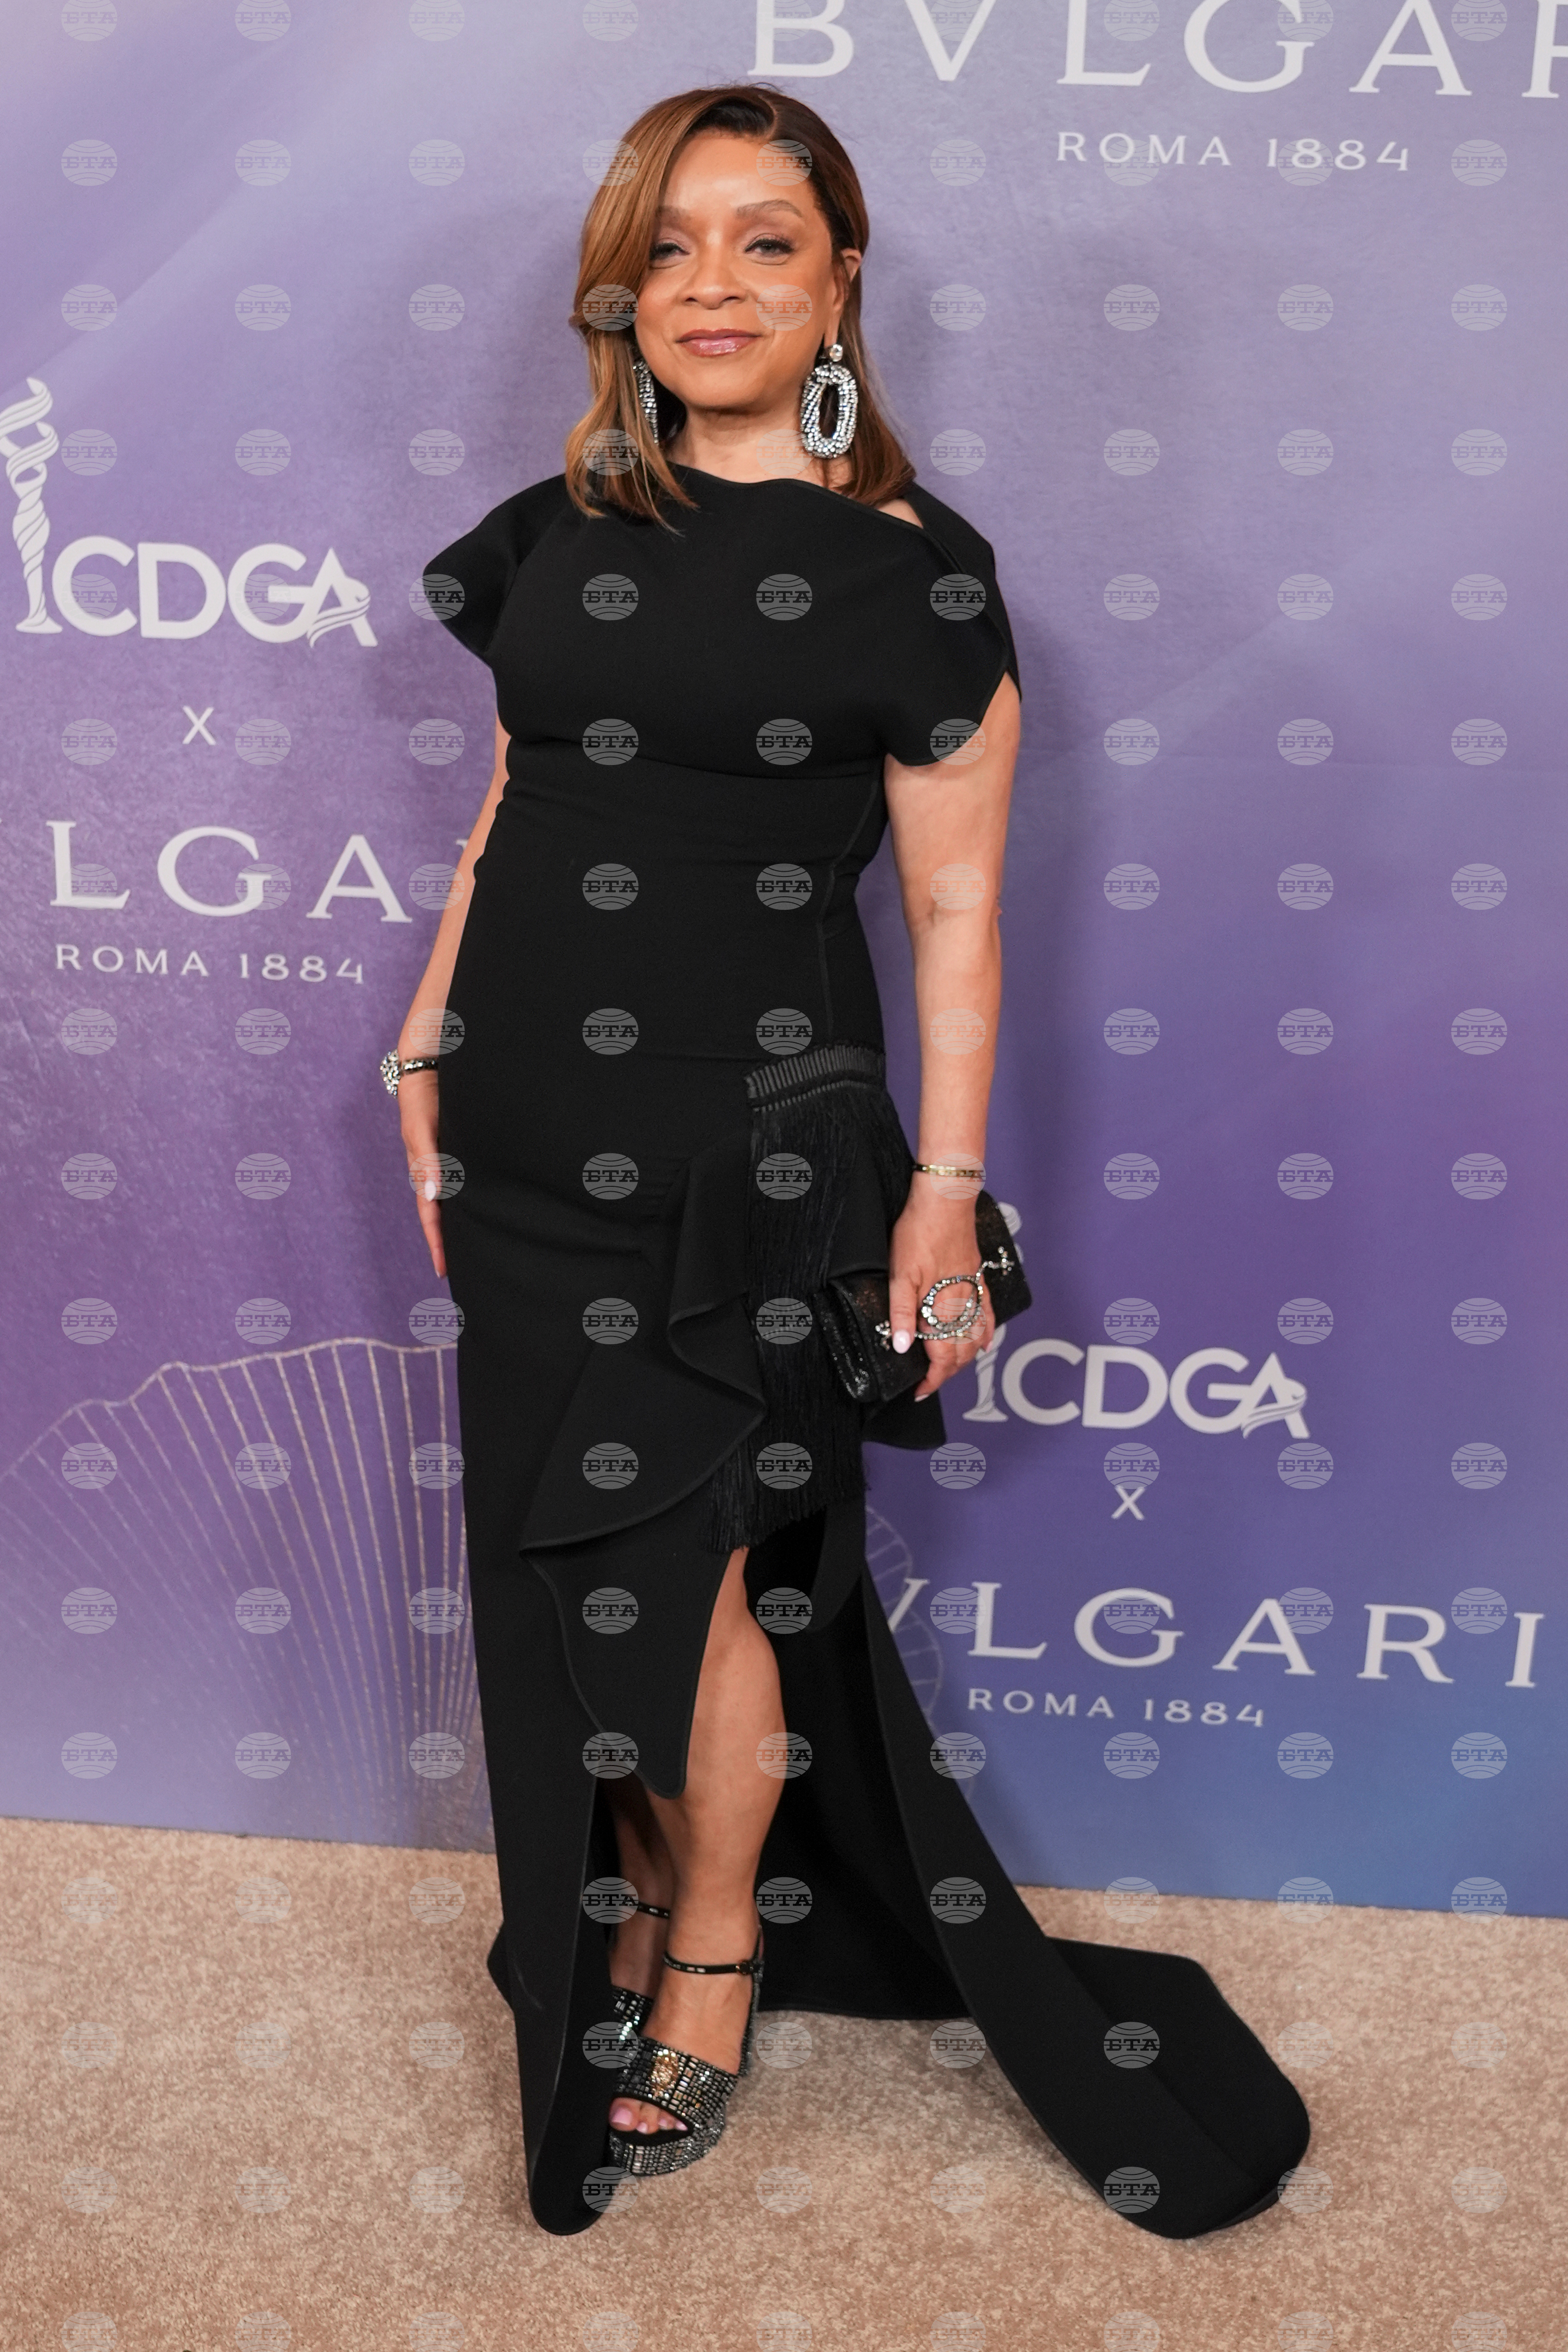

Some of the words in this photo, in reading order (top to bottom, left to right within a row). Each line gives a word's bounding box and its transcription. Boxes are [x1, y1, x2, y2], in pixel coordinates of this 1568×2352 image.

[1057, 131, 1231, 166] ROMA
[1267, 138, 1408, 171] 1884
[56, 944, 209, 977] ROMA
[239, 953, 363, 984] 1884
[968, 1687, 1114, 1719] ROMA
[1144, 1698, 1264, 1728] 1884
